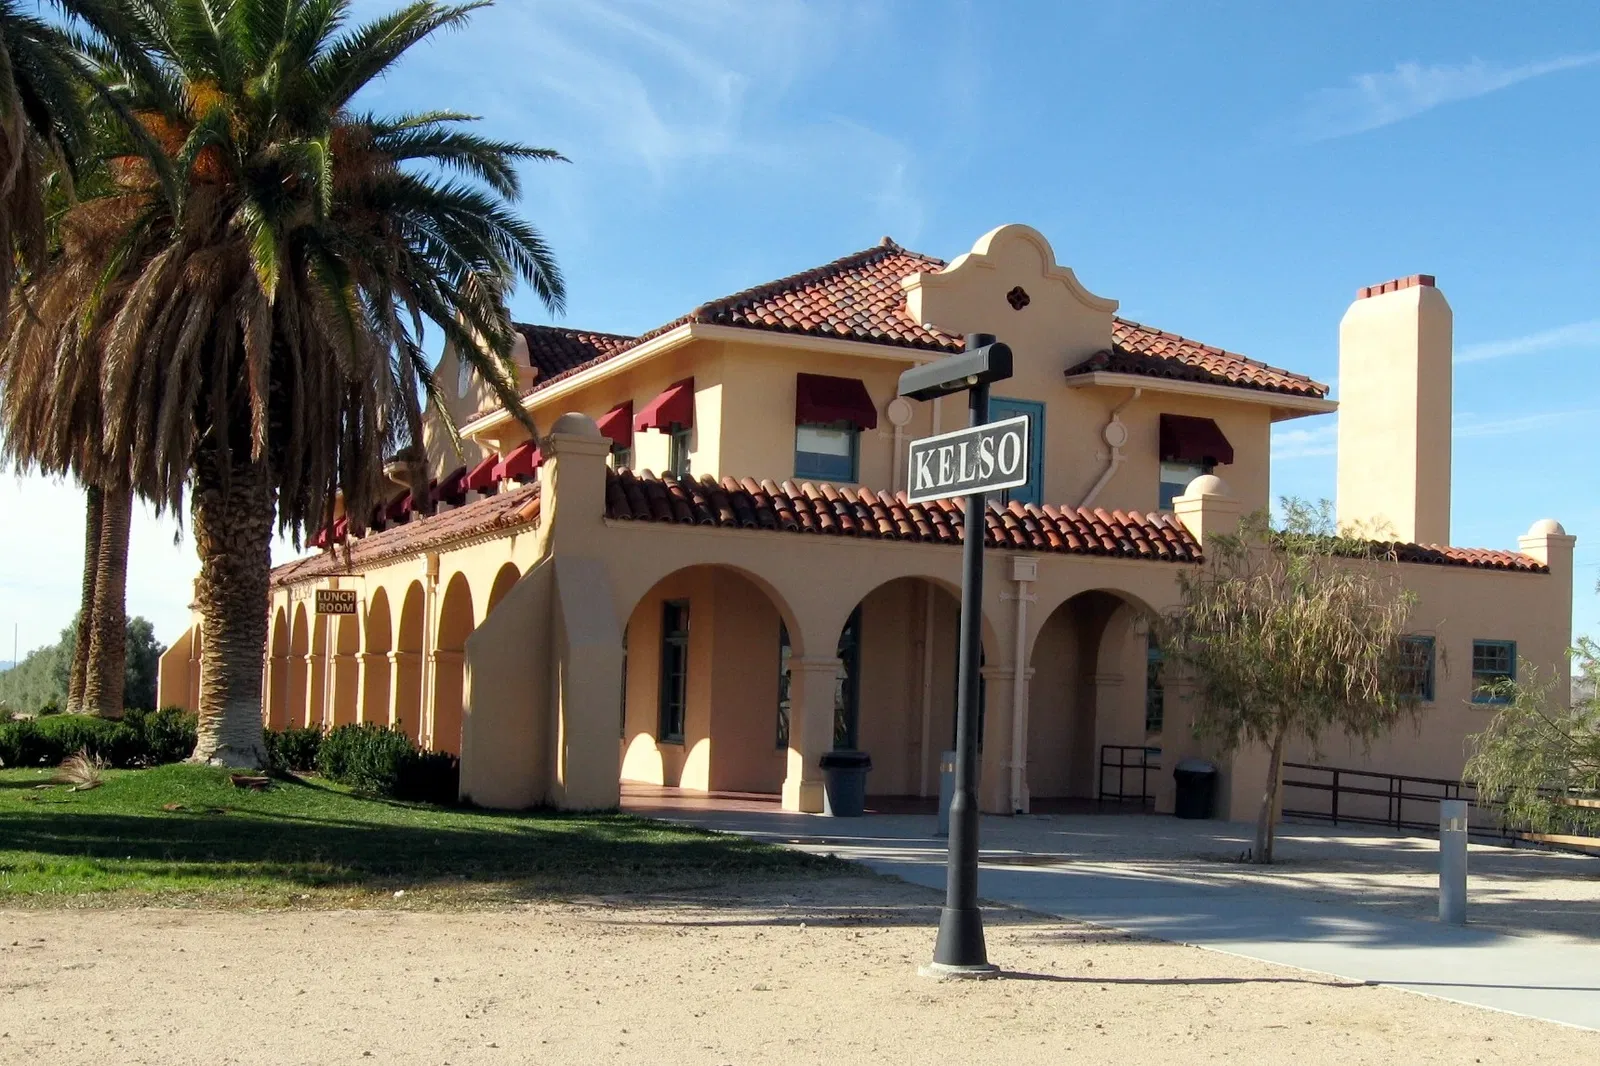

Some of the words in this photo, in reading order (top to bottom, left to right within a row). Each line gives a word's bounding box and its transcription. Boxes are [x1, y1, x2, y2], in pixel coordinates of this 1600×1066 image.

[914, 431, 1021, 491] KELSO
[317, 591, 355, 602] LUNCH
[318, 602, 354, 613] ROOM
